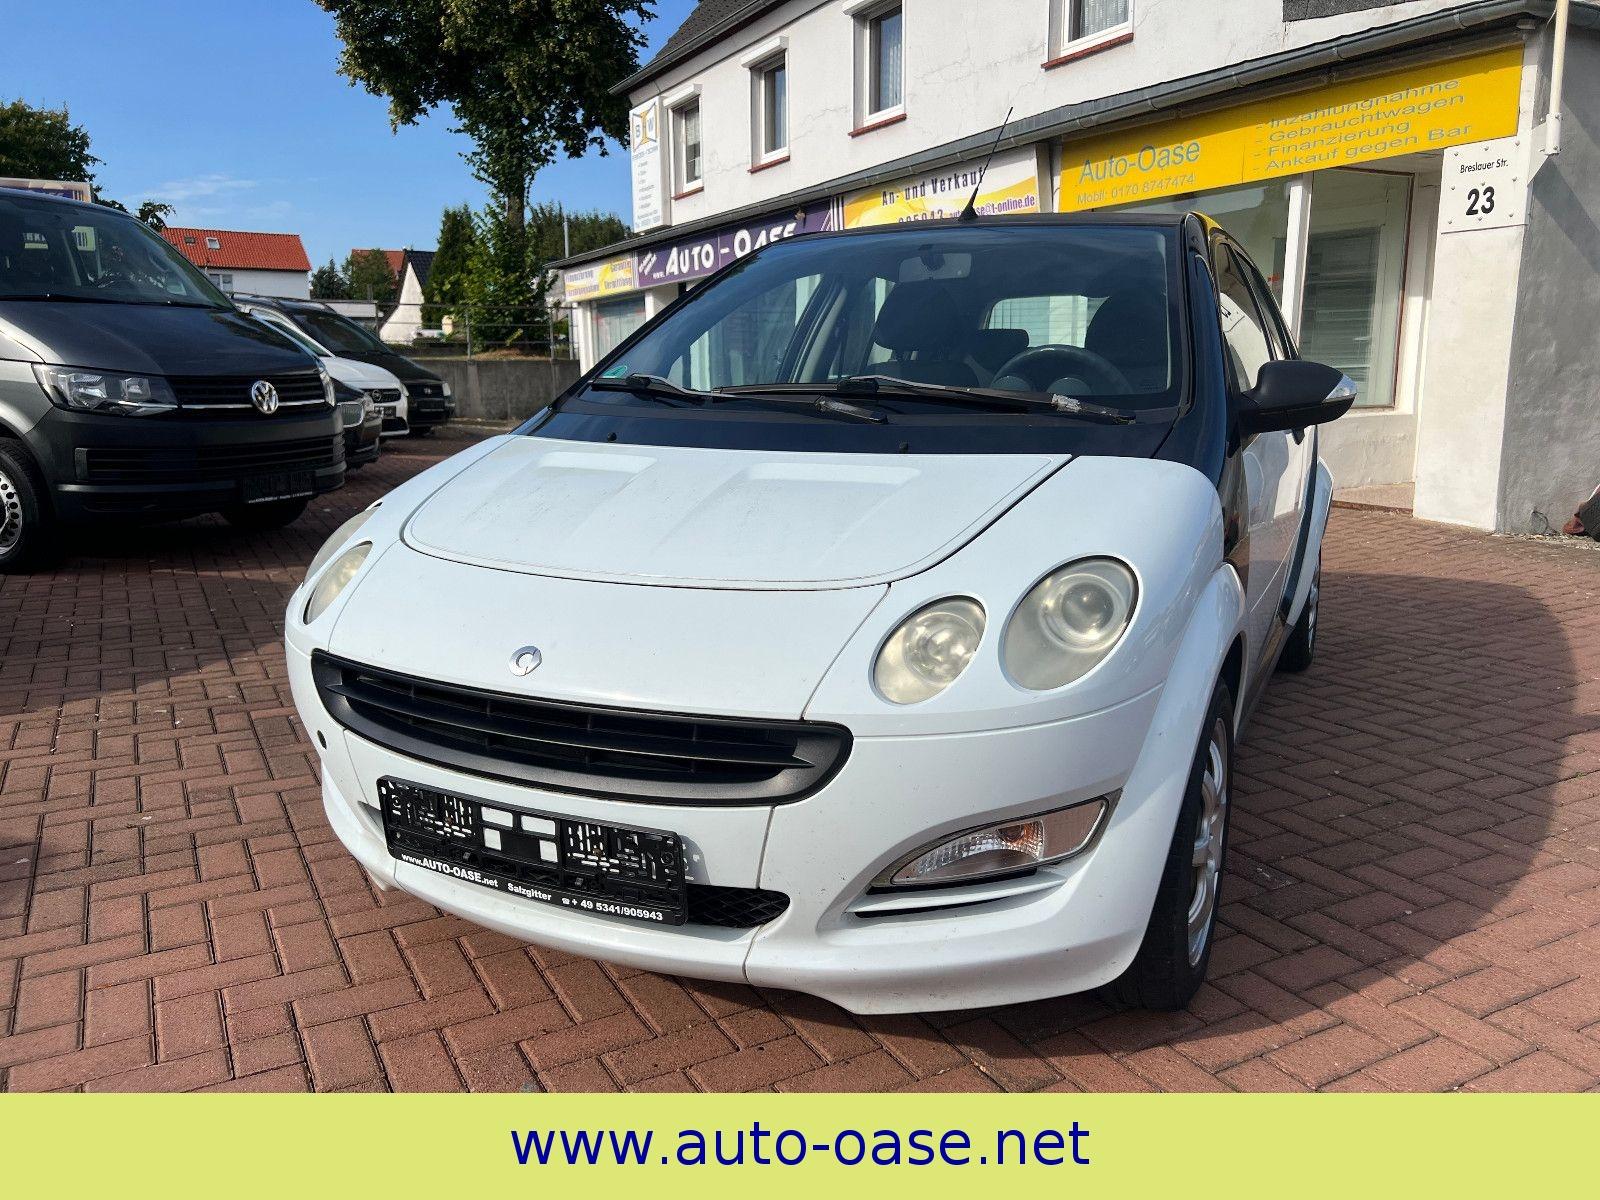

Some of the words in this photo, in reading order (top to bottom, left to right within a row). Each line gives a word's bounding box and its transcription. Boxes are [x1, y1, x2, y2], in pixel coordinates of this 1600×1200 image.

[1269, 79, 1460, 129] Inzahlungnahme
[1269, 93, 1465, 142] Gebrauchtwagen
[1266, 149, 1339, 171] Ankauf
[1345, 135, 1419, 158] gegen
[1428, 125, 1472, 141] Bar
[1268, 120, 1411, 157] Finanzierung
[1079, 140, 1201, 185] Auto-Oase
[1460, 161, 1495, 174] Breslauer
[1496, 158, 1509, 168] Str.
[882, 191, 899, 206] An-
[905, 182, 926, 200] und
[931, 168, 984, 194] Verkauf
[1077, 190, 1107, 205] Mobil:
[1111, 184, 1139, 199] 0170
[1142, 172, 1197, 192] 8747474
[1465, 186, 1495, 216] 23
[401, 853, 499, 888] www.AUTO-OASE.net
[507, 882, 552, 901] Salzgitter
[580, 899, 594, 909] 49
[596, 902, 663, 921] 5341/905943
